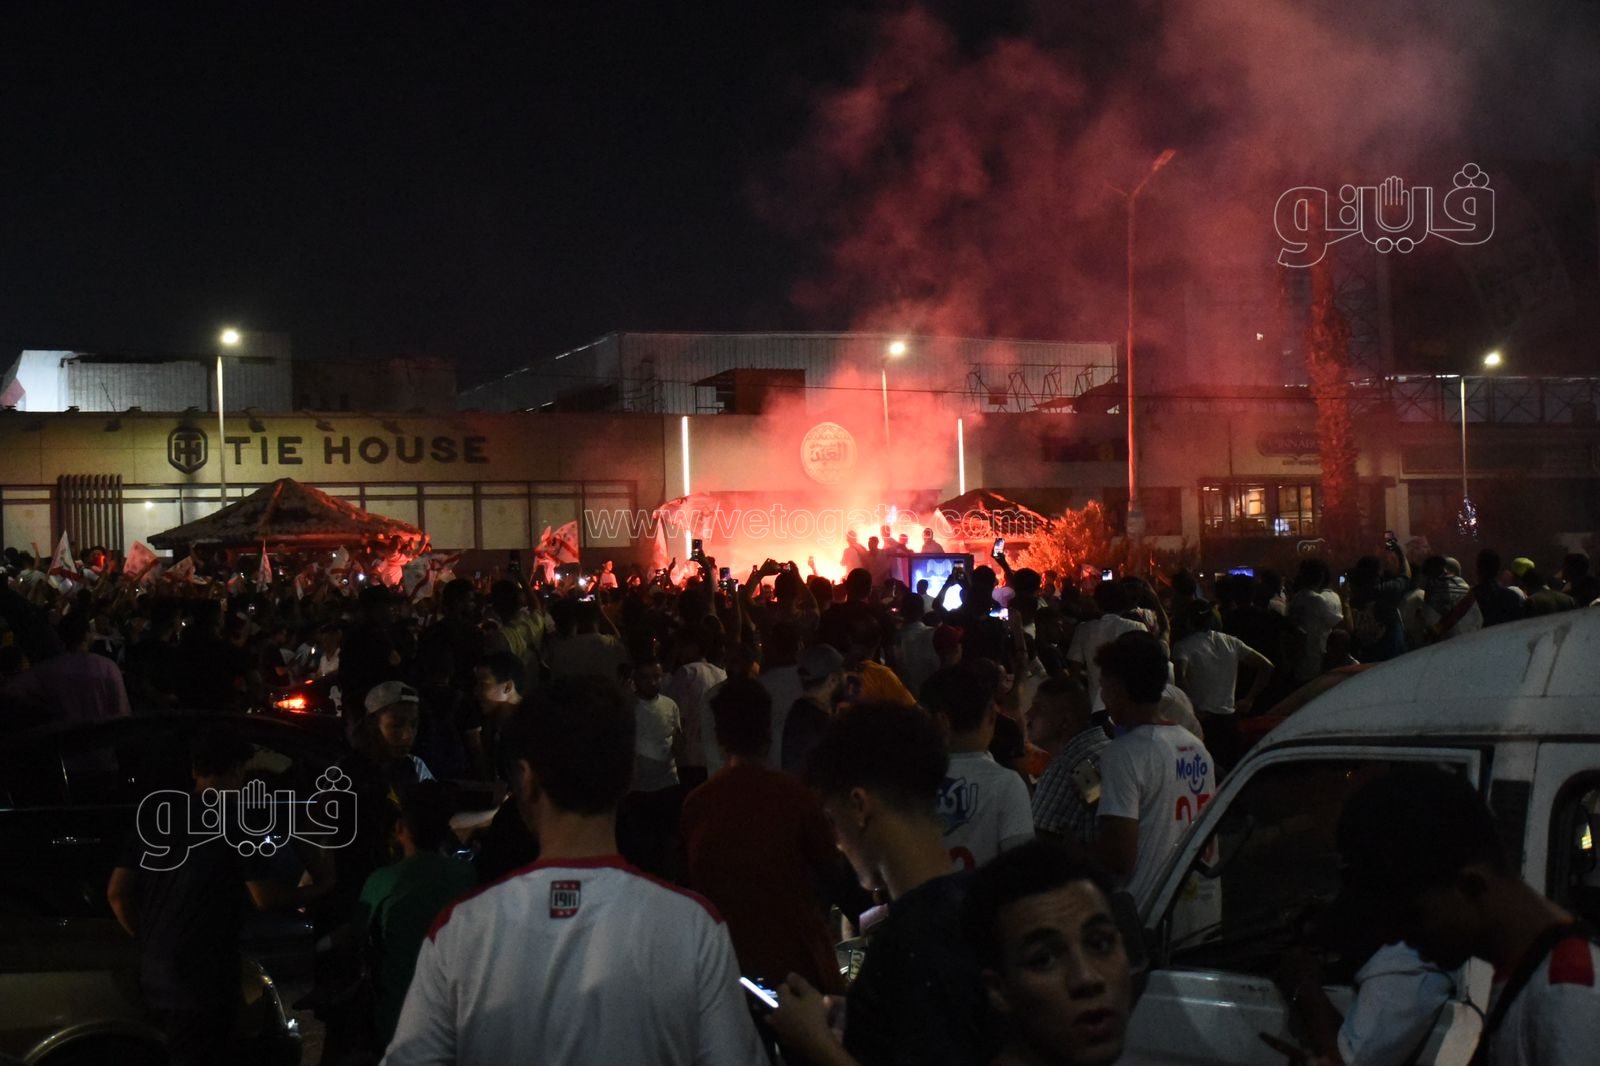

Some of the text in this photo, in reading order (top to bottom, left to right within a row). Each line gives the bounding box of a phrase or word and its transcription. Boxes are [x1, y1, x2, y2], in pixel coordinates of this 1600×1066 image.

[224, 435, 491, 465] TIE HOUSE
[1175, 753, 1208, 786] Molto
[554, 892, 577, 907] 1911
